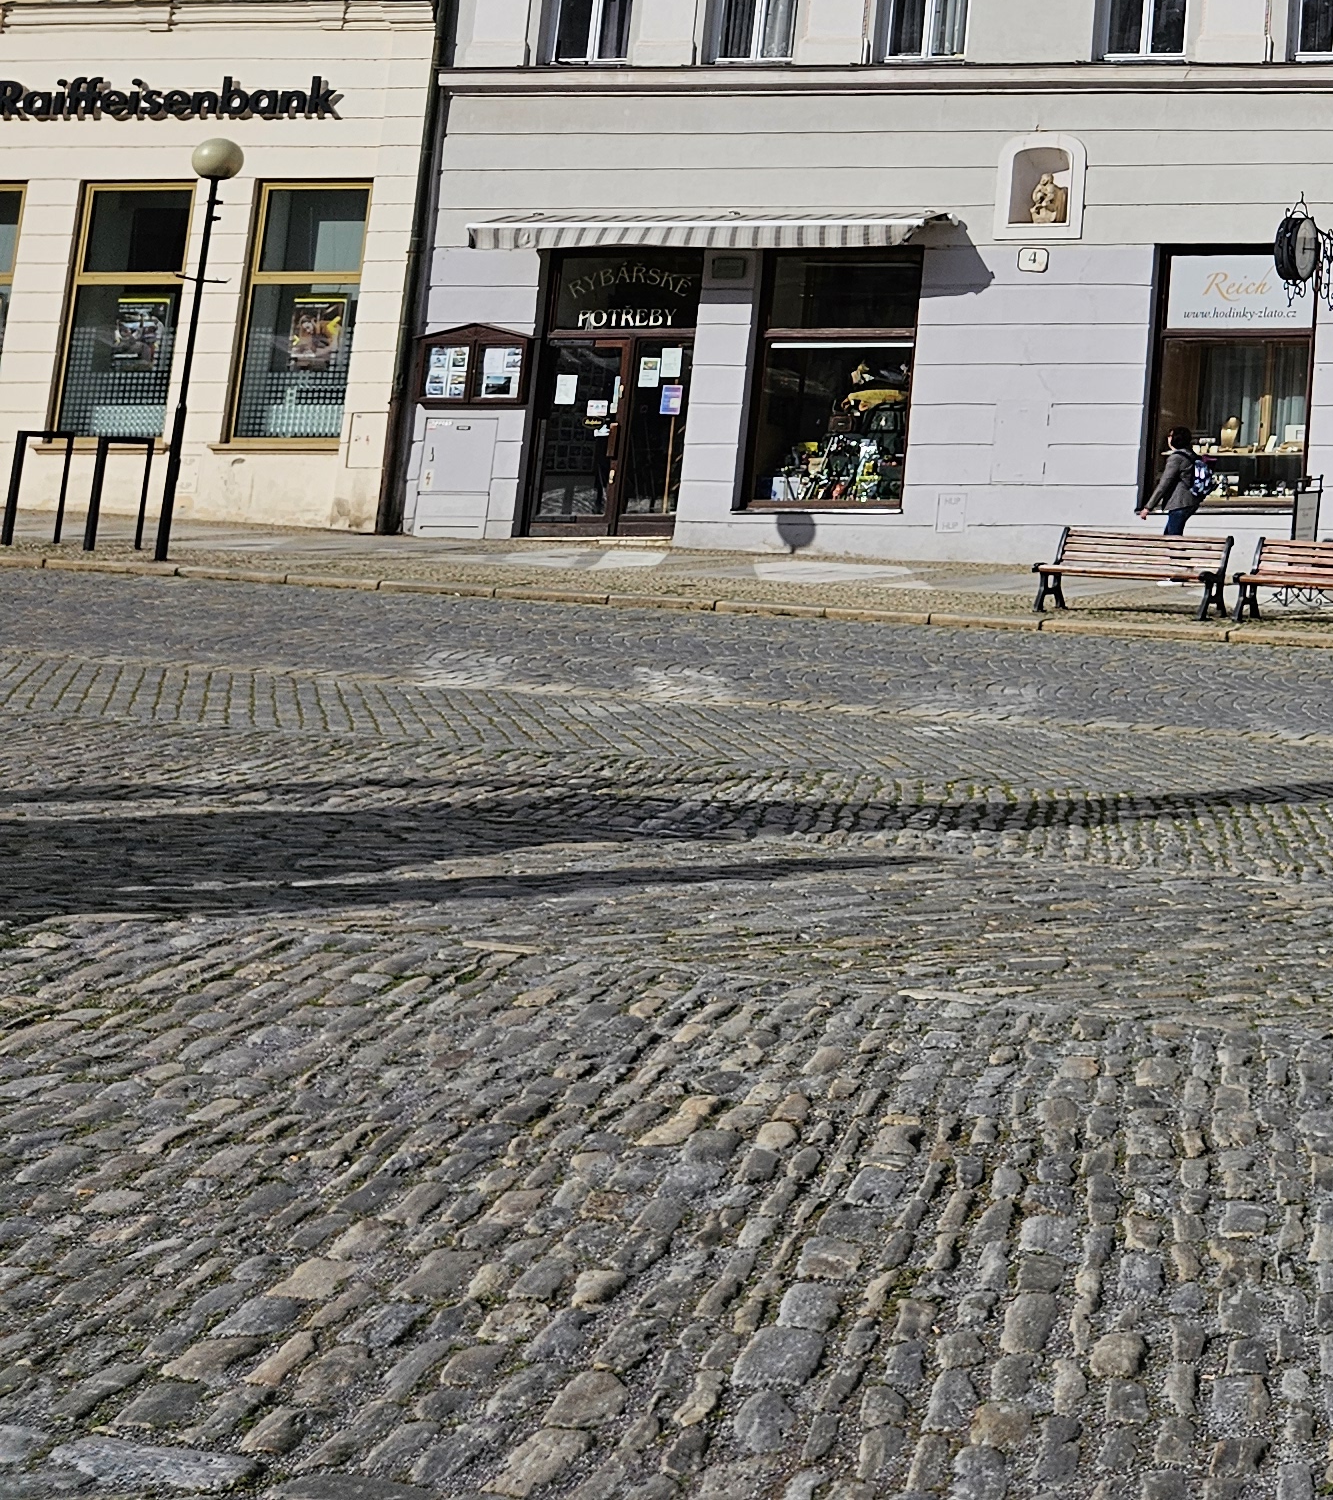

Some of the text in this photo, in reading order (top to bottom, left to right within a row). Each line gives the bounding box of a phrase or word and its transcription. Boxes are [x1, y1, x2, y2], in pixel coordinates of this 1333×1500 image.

[0, 76, 336, 117] Raiffeisenbank
[1029, 251, 1037, 264] 4
[568, 261, 692, 299] RYBÁŘSKÉ
[1202, 265, 1275, 302] Reich
[577, 306, 677, 327] POTŘEBY
[1183, 307, 1297, 321] www.hodinky-zlato.cz
